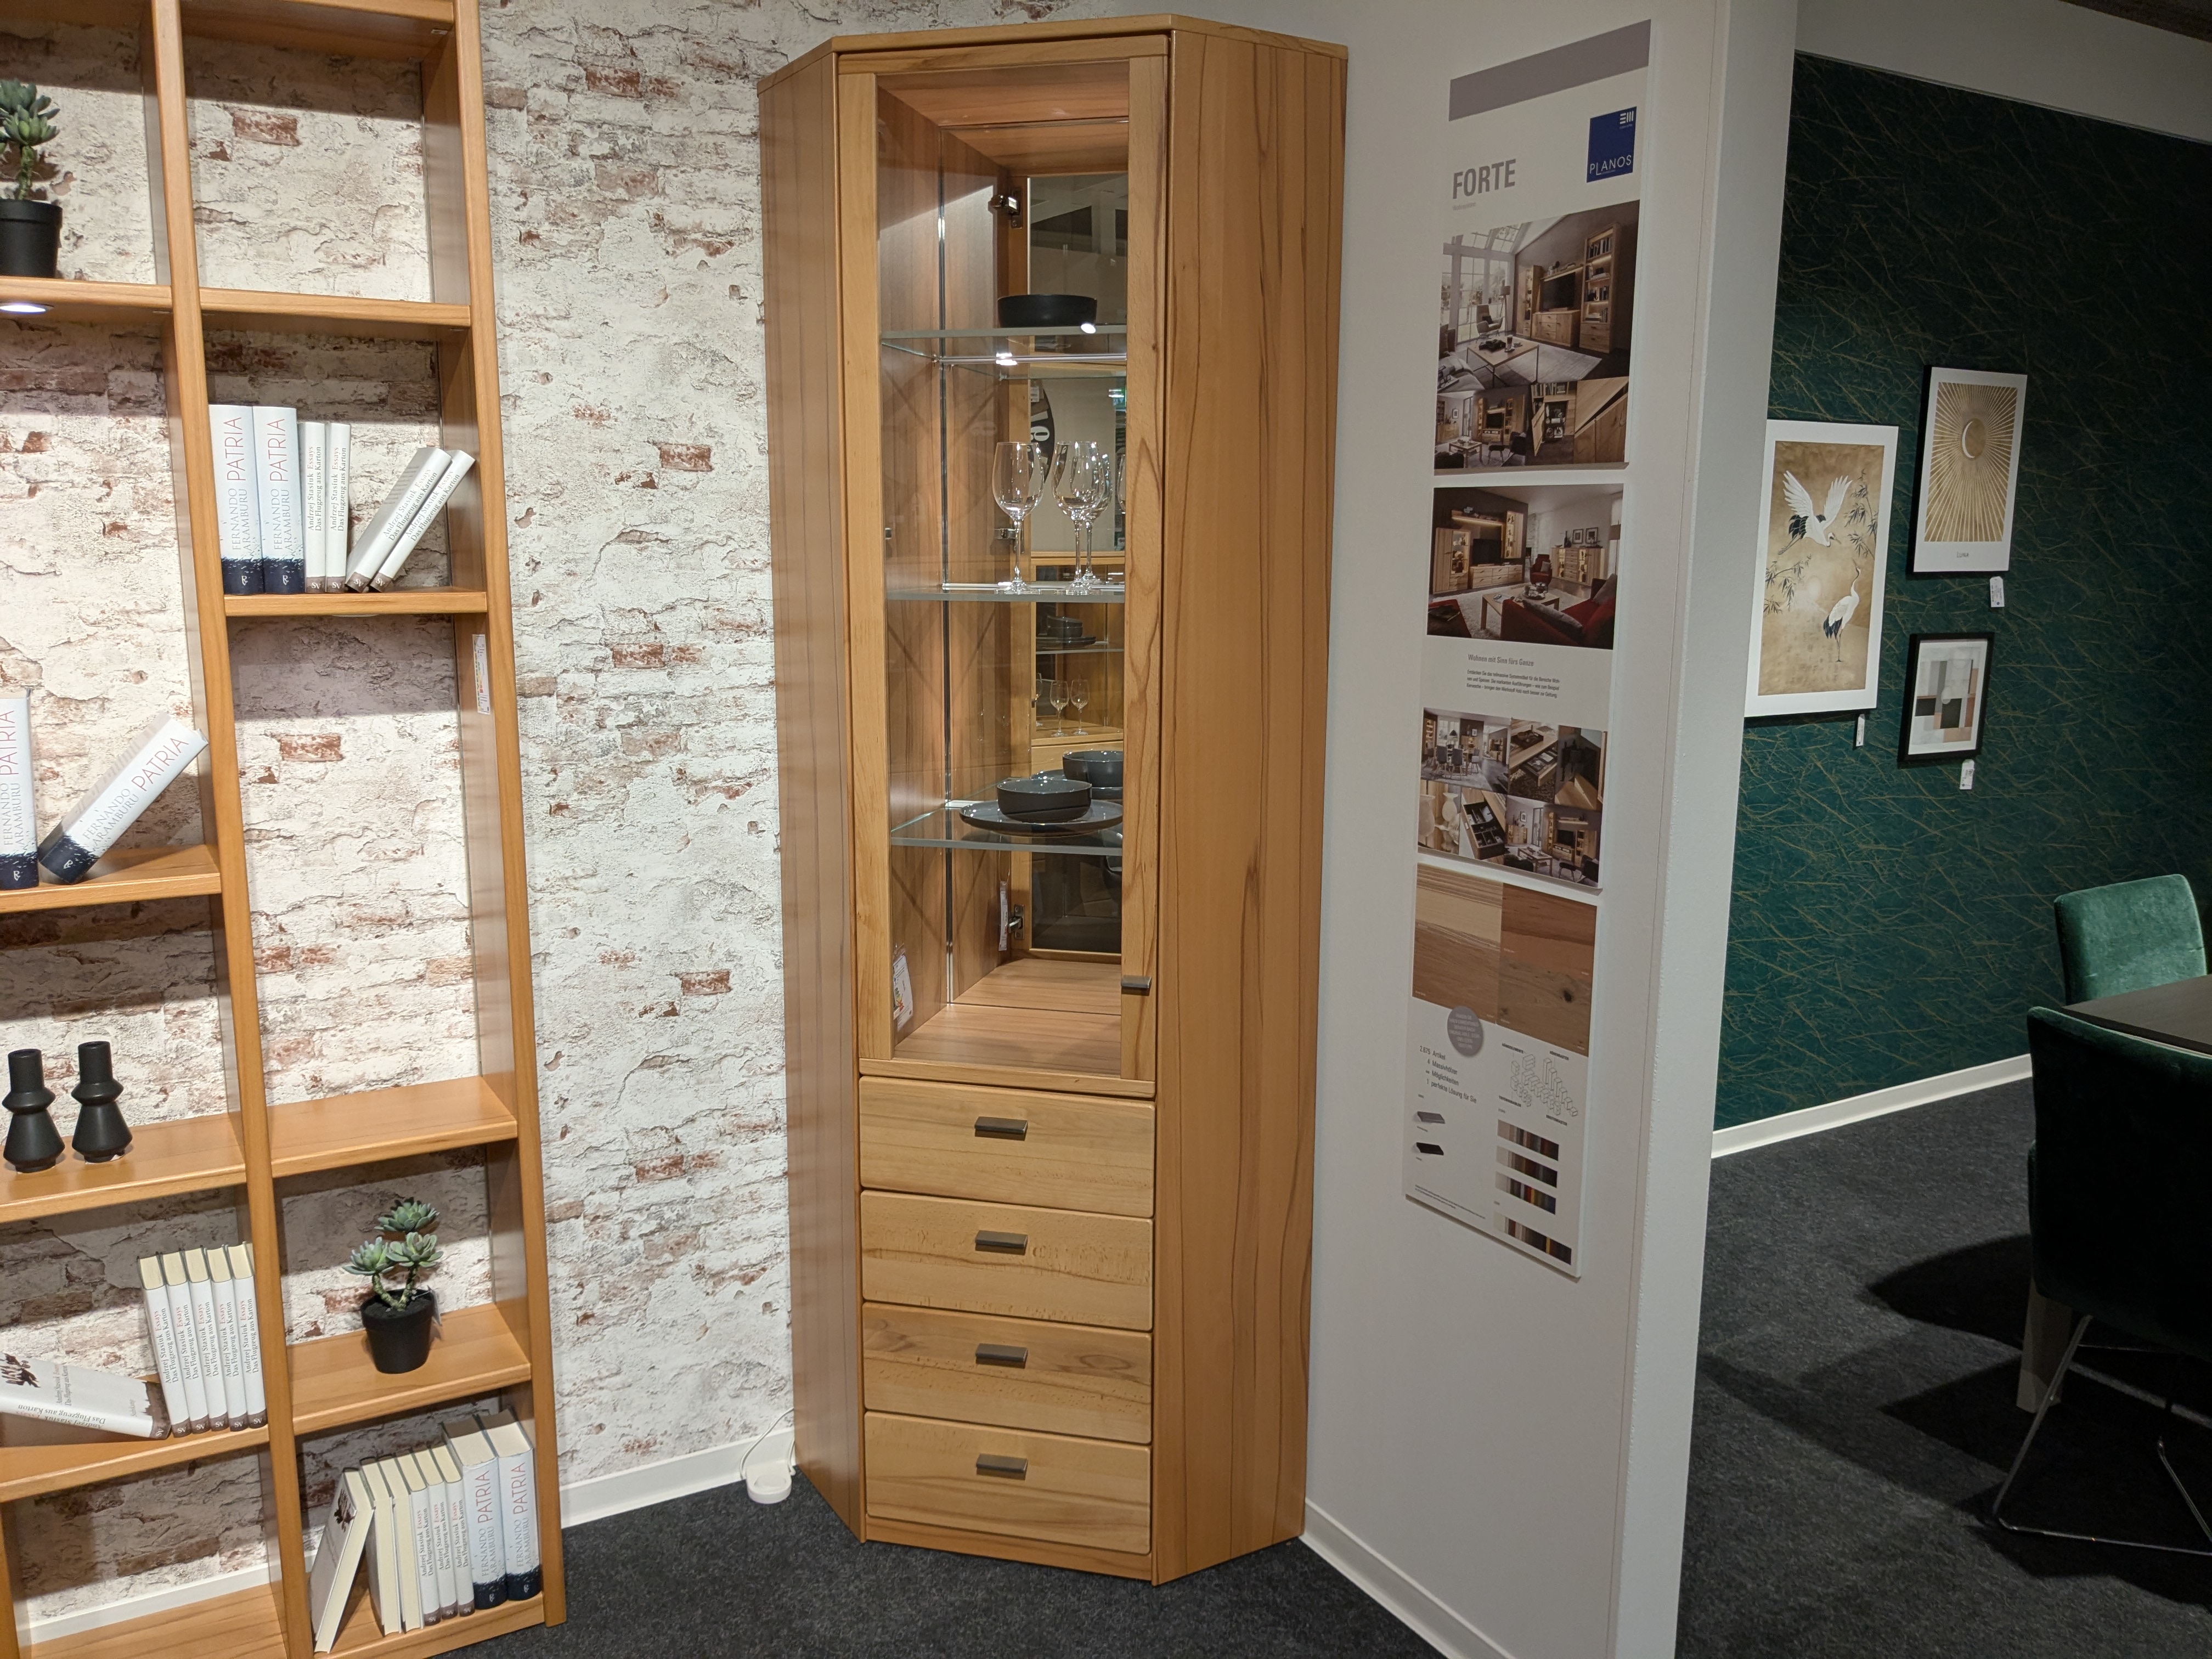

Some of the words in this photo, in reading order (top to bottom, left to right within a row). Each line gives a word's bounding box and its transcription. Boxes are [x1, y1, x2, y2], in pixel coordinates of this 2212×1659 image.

[1453, 159, 1516, 199] FORTE
[1589, 155, 1632, 176] PLANOS
[223, 417, 246, 481] PATRIA
[267, 419, 288, 481] PATRIA
[332, 448, 340, 470] Essays
[338, 486, 346, 517] Flugzeug
[383, 512, 403, 537] Andrzej
[398, 490, 417, 515] Stasiuk
[415, 469, 431, 488] Essays
[388, 526, 400, 541] Das
[397, 502, 418, 532] Flugzeug
[415, 492, 425, 503] aus
[422, 472, 437, 494] Karton
[405, 512, 425, 537] Andrzej
[424, 491, 439, 515] Stasiuk
[438, 470, 454, 489] Essays
[410, 527, 421, 541] Das
[419, 504, 441, 533] Flugzeug
[438, 494, 447, 505] aus
[445, 474, 460, 495] Karton
[228, 488, 241, 550] FERNANDO
[239, 489, 251, 551] ARAMBURU
[270, 489, 283, 550] FERNANDO
[281, 489, 292, 551] ARAMBURU
[307, 503, 315, 531] Andrzej
[330, 503, 338, 531] Andrzej
[1468, 654, 1487, 662] Wohnen
[1519, 658, 1534, 667] Ganze
[131, 738, 189, 791] PATRIA
[1, 783, 13, 845] FERNANDO
[10, 783, 24, 845] ARAMBURU
[83, 788, 131, 839] FERNANDO
[93, 794, 139, 846] ARAMBURU
[1432, 1051, 1446, 1060] Artikel
[1431, 1081, 1448, 1092] perfekte
[1448, 1087, 1462, 1099] Lösung
[156, 1334, 166, 1358] Stasiuk
[178, 1330, 188, 1355] Stasiuk
[199, 1327, 208, 1351] Stasiuk
[210, 1335, 218, 1364] Flugzeug
[221, 1327, 229, 1351] Stasiuk
[241, 1324, 249, 1347] Stasiuk
[182, 1355, 191, 1380] Andrzej
[189, 1338, 197, 1367] Flugzeug
[202, 1352, 212, 1377] Andrzej
[223, 1352, 232, 1377] Andrzej
[244, 1348, 252, 1374] Andrzej
[162, 1359, 171, 1384] Andrzej
[18, 1405, 43, 1414] Karton
[59, 1410, 91, 1423] Flugzeug
[475, 1470, 493, 1523] PATRIA
[511, 1462, 528, 1514] PATRIA
[417, 1532, 426, 1553] Stasiuk
[435, 1525, 443, 1547] Stasiuk
[487, 1526, 496, 1576] ARAMBURU
[514, 1520, 524, 1567] FERNANDO
[522, 1517, 532, 1565] ARAMBURU
[478, 1528, 489, 1577] FERNANDO
